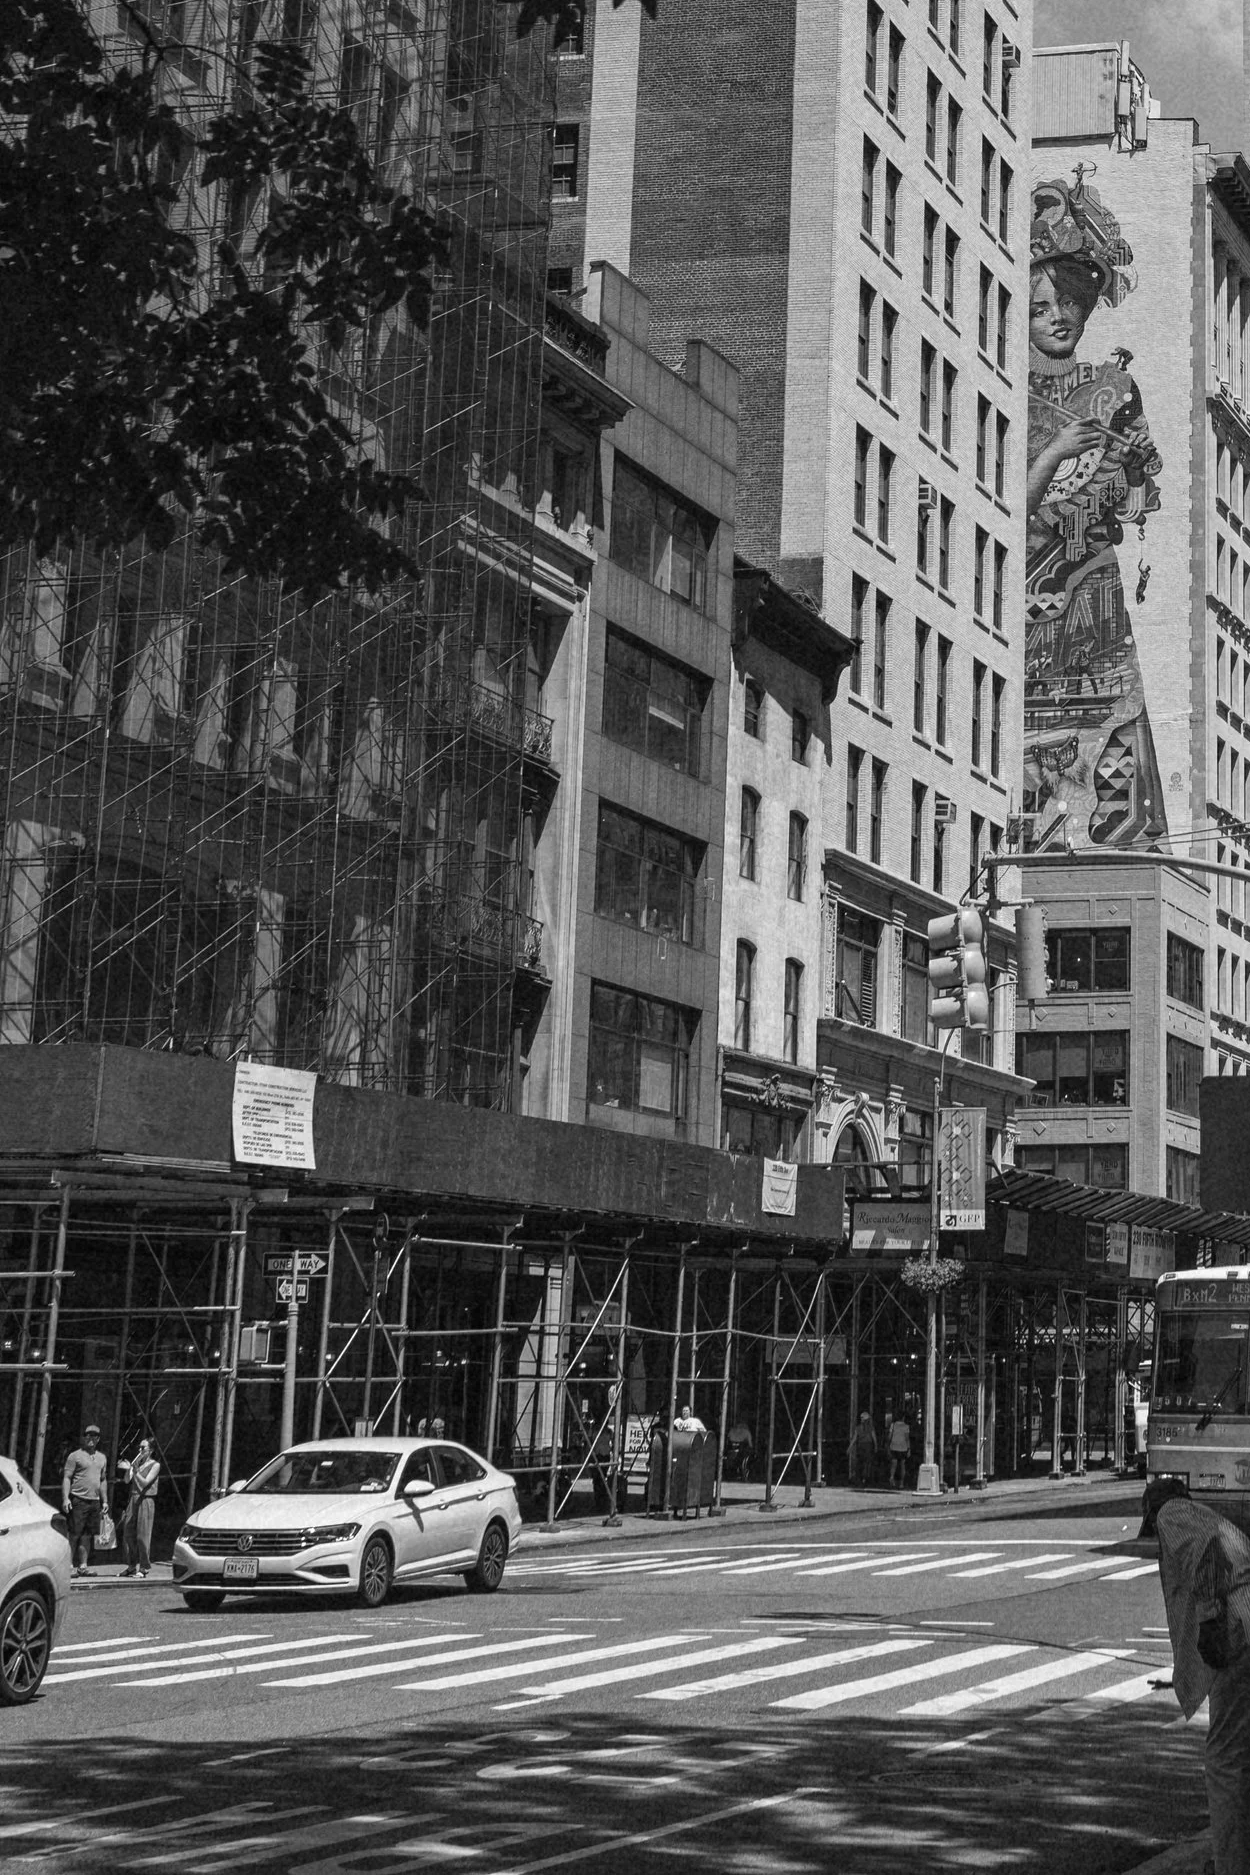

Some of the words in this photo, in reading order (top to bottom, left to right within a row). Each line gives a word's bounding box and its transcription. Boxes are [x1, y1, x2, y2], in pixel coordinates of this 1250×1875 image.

[857, 1211, 895, 1224] Riccardo
[895, 1212, 930, 1225] Maggio
[273, 1259, 292, 1269] ONE
[300, 1259, 320, 1269] WAY
[1183, 1283, 1218, 1303] BxM2
